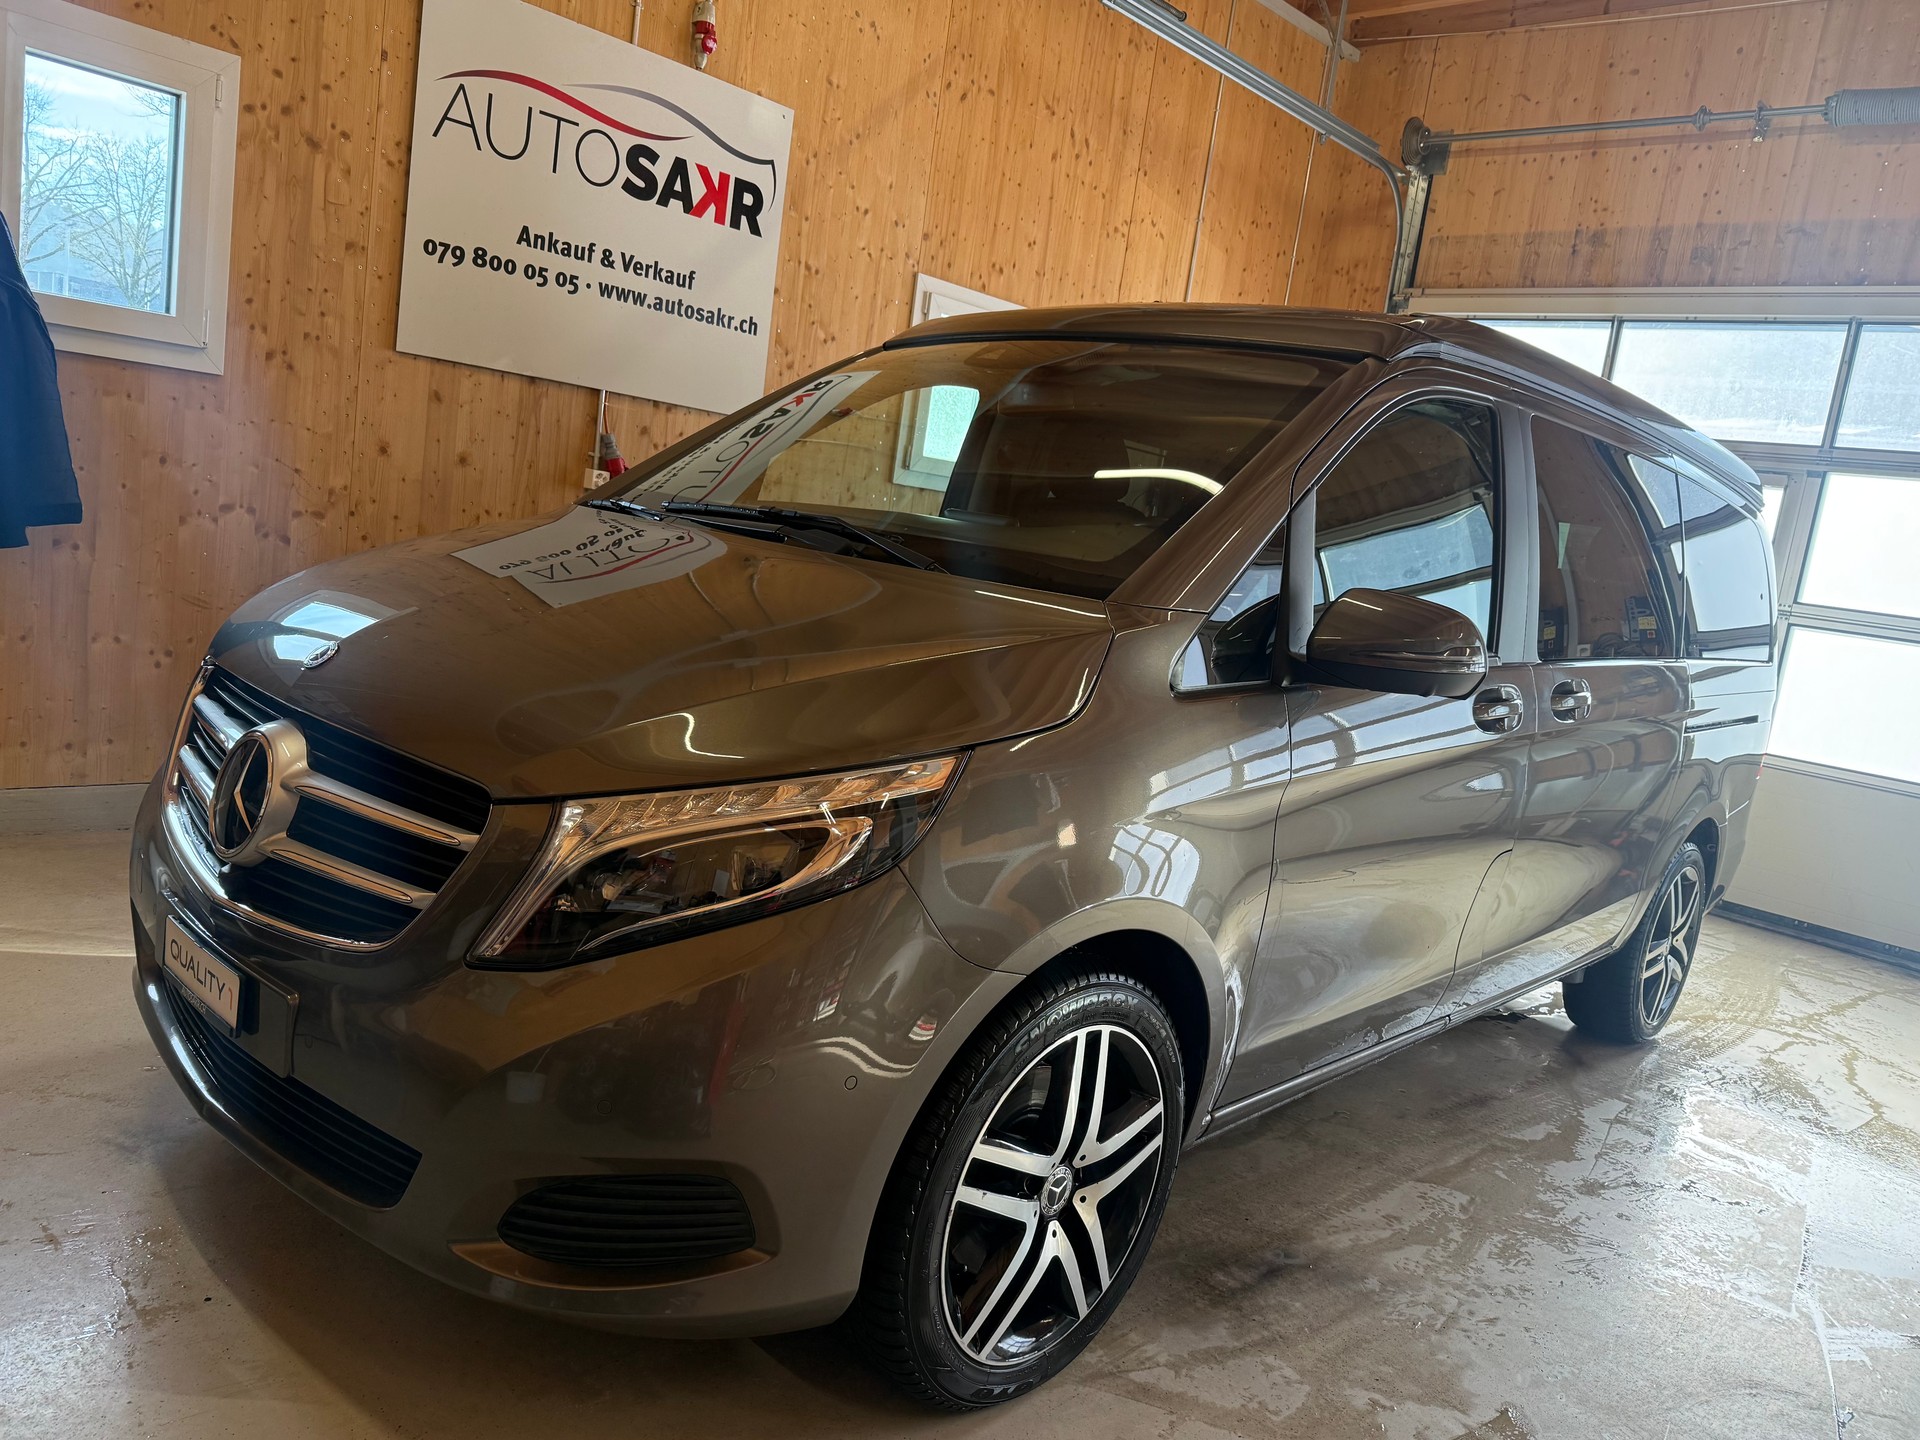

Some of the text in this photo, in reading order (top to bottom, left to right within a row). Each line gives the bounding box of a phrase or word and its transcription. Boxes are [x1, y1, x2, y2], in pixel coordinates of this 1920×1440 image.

[422, 237, 759, 337] 079 800 05 05 www.autosakr.ch
[516, 224, 696, 290] Ankauf & Verkauf
[170, 938, 226, 1001] QUALITY
[228, 986, 234, 1010] 1
